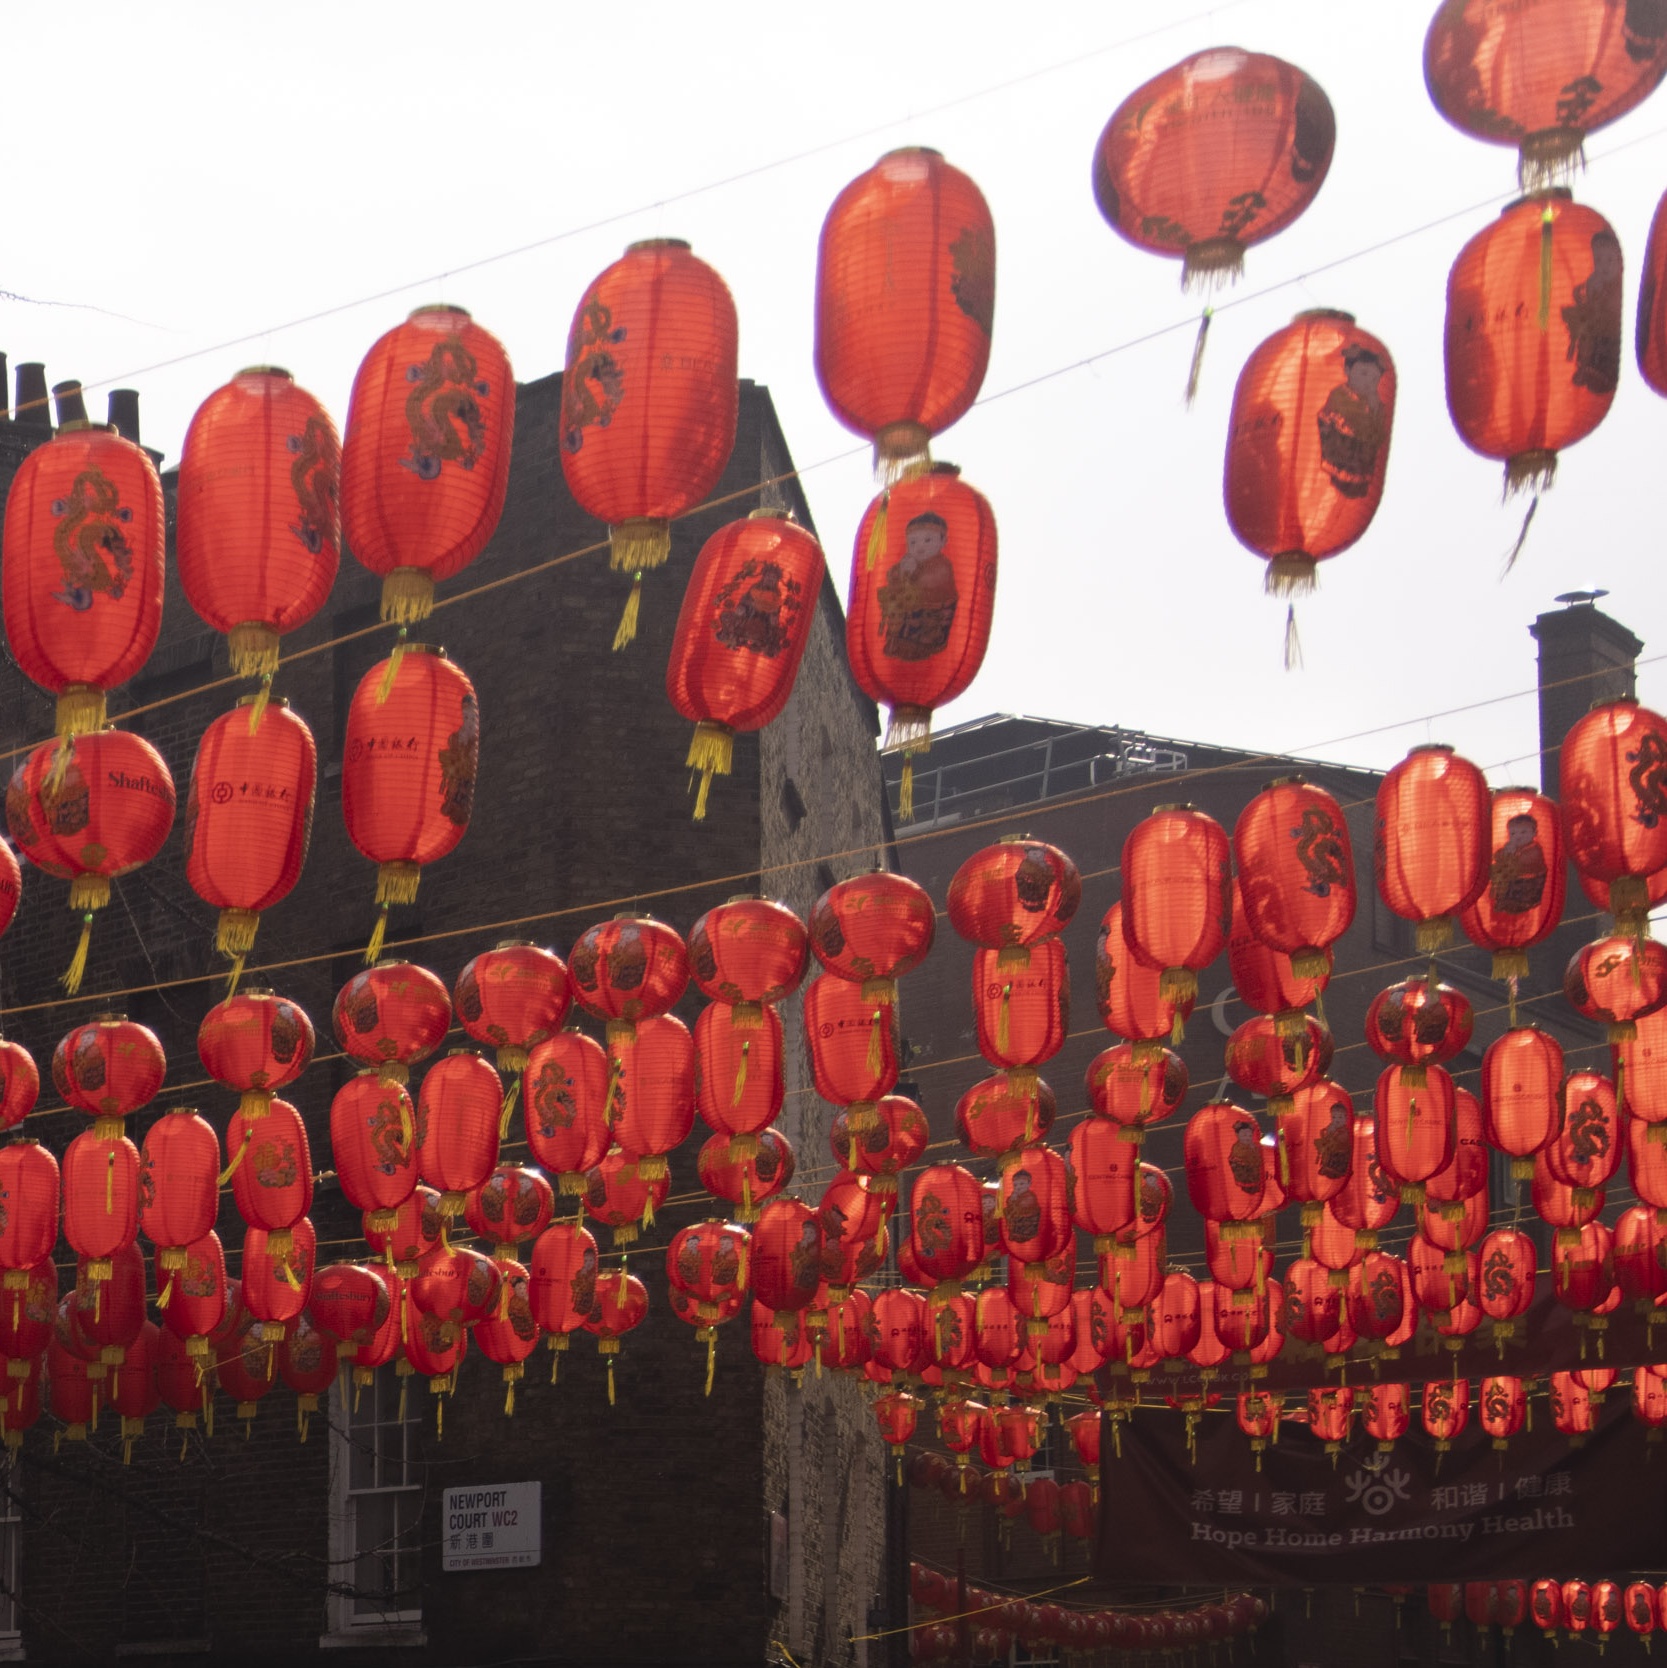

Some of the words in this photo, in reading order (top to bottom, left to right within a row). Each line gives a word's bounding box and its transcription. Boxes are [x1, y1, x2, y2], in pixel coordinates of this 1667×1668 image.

[450, 1491, 507, 1510] NEWPORT
[1191, 1489, 1244, 1516] 希望
[1270, 1491, 1327, 1517] 家庭
[1431, 1482, 1489, 1512] 和谐
[1514, 1470, 1573, 1500] 健康
[450, 1512, 487, 1530] COURT
[492, 1510, 518, 1527] WC2
[1191, 1522, 1257, 1551] Hope
[1267, 1526, 1343, 1547] Home
[1350, 1515, 1474, 1545] Harmony
[1481, 1506, 1574, 1533] Health
